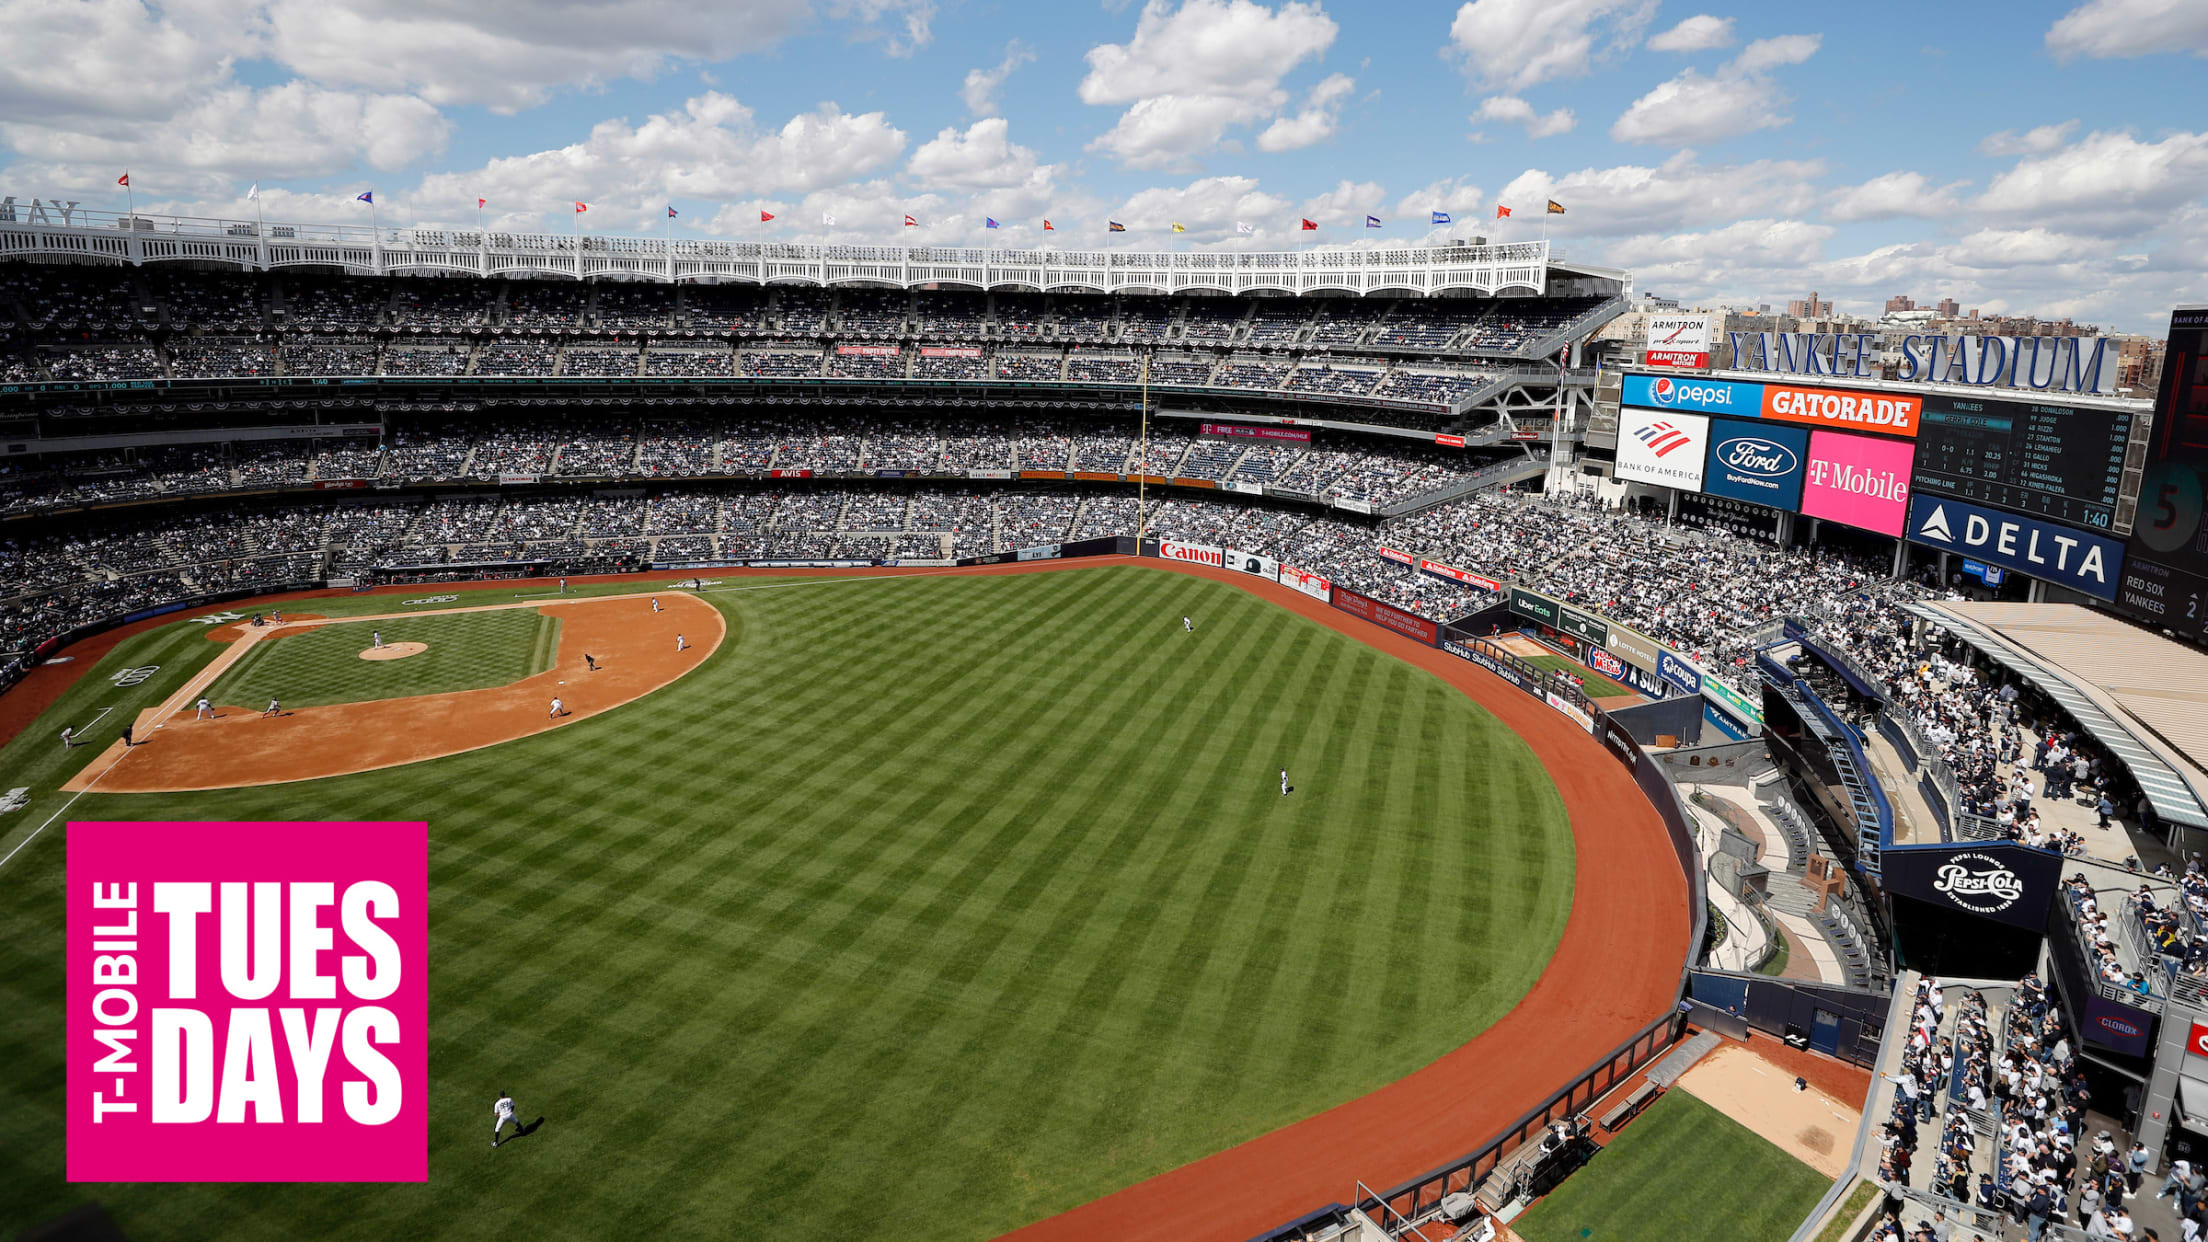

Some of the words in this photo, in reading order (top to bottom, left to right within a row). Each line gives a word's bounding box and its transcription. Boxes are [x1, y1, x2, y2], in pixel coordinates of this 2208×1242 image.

[1651, 320, 1704, 330] ARMITRON
[1650, 351, 1698, 362] ARMITRON
[1728, 331, 1880, 378] YANKEE
[1897, 335, 2116, 394] STADIUM
[1677, 386, 1731, 406] pepsi
[1772, 390, 1913, 428] GATORADE
[1952, 401, 1984, 412] YANKEES
[2040, 406, 2074, 416] DONALDSON
[2036, 434, 2061, 443] STANTON
[1729, 441, 1783, 472] Ford
[2033, 453, 2050, 462] GALLO
[780, 469, 801, 478] AVIS
[1617, 461, 1642, 472] BANK
[1644, 465, 1656, 474] OF
[1657, 467, 1700, 482] AMERICA
[2031, 462, 2048, 471] HICKS
[1726, 473, 1779, 490] BuyFordNow.com
[1915, 475, 1942, 486] PITCHING
[1942, 480, 1956, 489] LINE
[2153, 483, 2179, 530] 5
[2083, 509, 2109, 528] 1:40
[1160, 543, 1221, 565] Canon
[1964, 513, 2106, 583] DELTA
[2126, 575, 2145, 590] RED
[2146, 581, 2165, 597] SOX
[1518, 598, 1534, 611] Uber
[1534, 604, 1551, 617] Eats
[2124, 591, 2166, 615] YANKEES
[2186, 601, 2197, 618] 2
[1443, 641, 1471, 660] StubHub
[1618, 641, 1637, 655] LOTTE
[1471, 653, 1497, 672] StubHub
[1496, 665, 1521, 686] StubHub
[1628, 666, 1637, 685] A
[1639, 670, 1663, 697] SUB
[1673, 664, 1697, 689] coupa
[1718, 716, 1747, 740] AMTRAK
[1949, 853, 1971, 864] PEPSI
[1972, 853, 2006, 870] LOUNGE
[1946, 891, 1996, 914] ESTABLISHED
[2101, 1016, 2137, 1036] CLOROX
